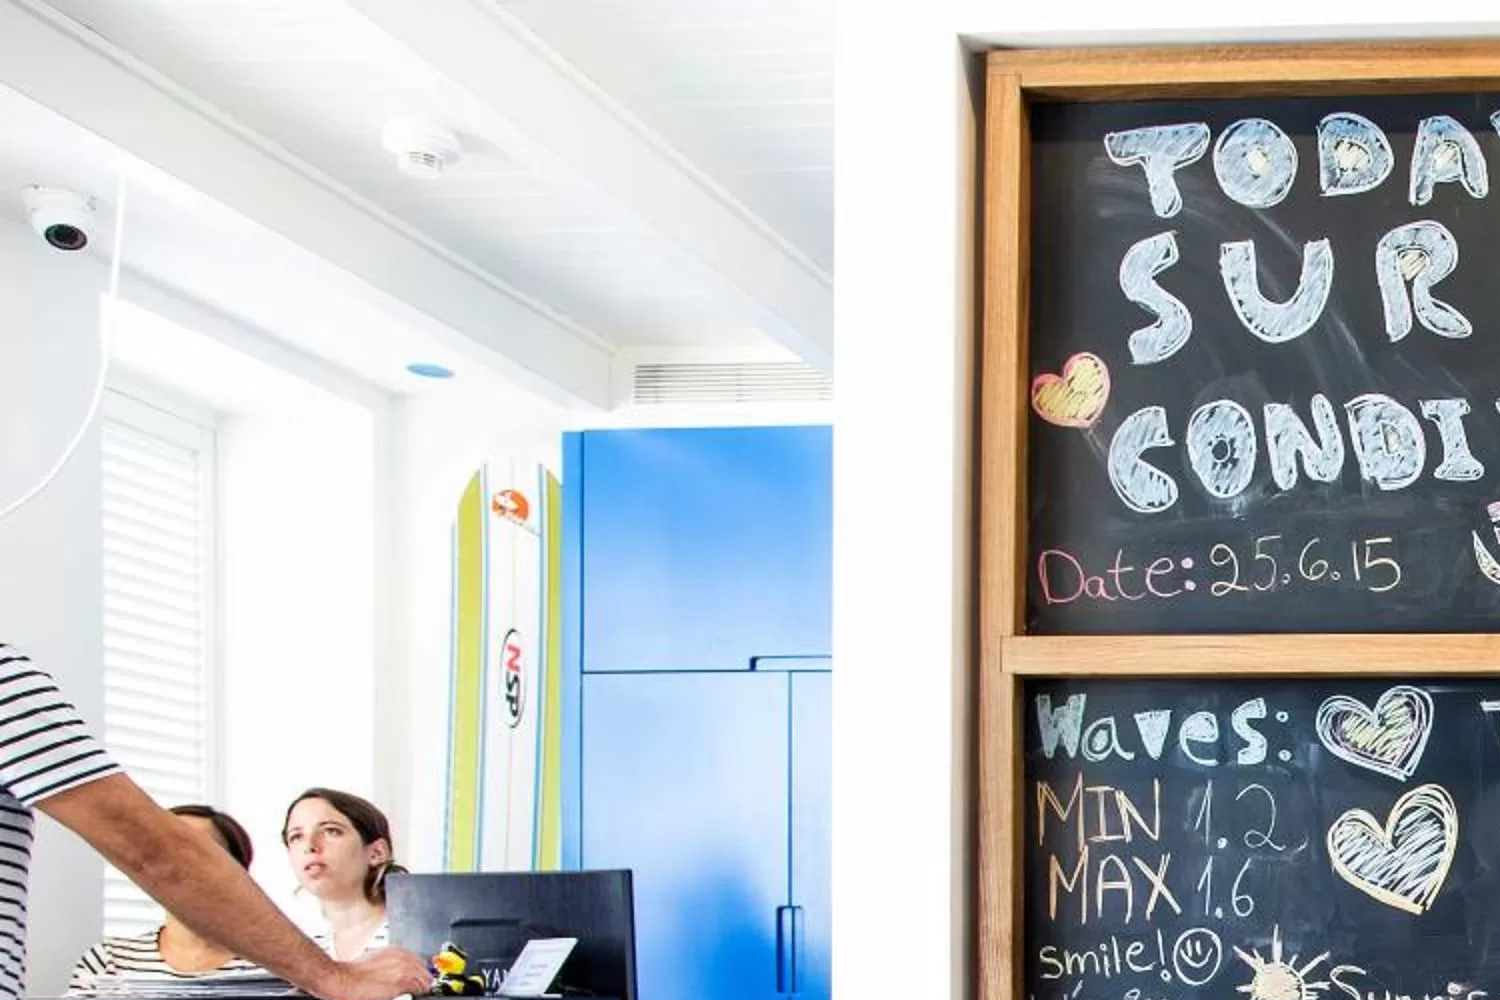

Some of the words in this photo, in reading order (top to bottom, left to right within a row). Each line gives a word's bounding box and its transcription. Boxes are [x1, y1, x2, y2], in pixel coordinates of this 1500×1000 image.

[1037, 549, 1198, 606] Date:
[1208, 535, 1402, 597] 25.6.15
[1035, 692, 1293, 766] Waves:
[1036, 771, 1161, 853] MIN
[1050, 844, 1183, 925] MAX
[1197, 855, 1255, 919] 1.6
[1039, 929, 1171, 981] smile!
